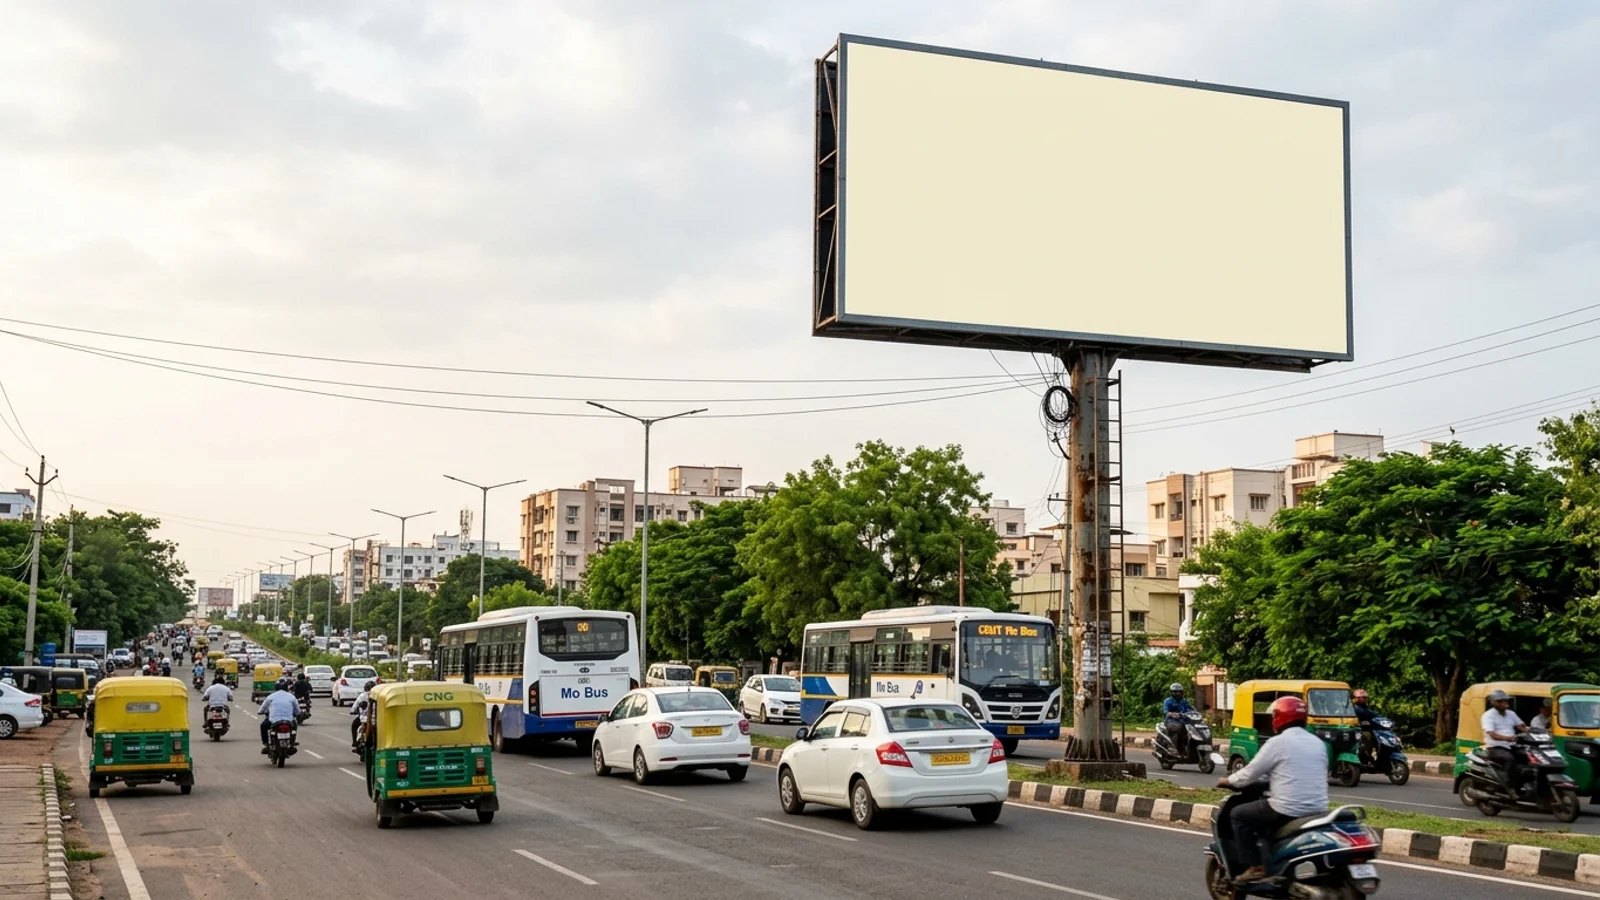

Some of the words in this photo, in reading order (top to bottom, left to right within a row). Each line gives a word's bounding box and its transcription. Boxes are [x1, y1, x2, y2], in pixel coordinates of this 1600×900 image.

[423, 692, 454, 702] CNG
[561, 687, 580, 699] Mo
[584, 686, 609, 699] Bus
